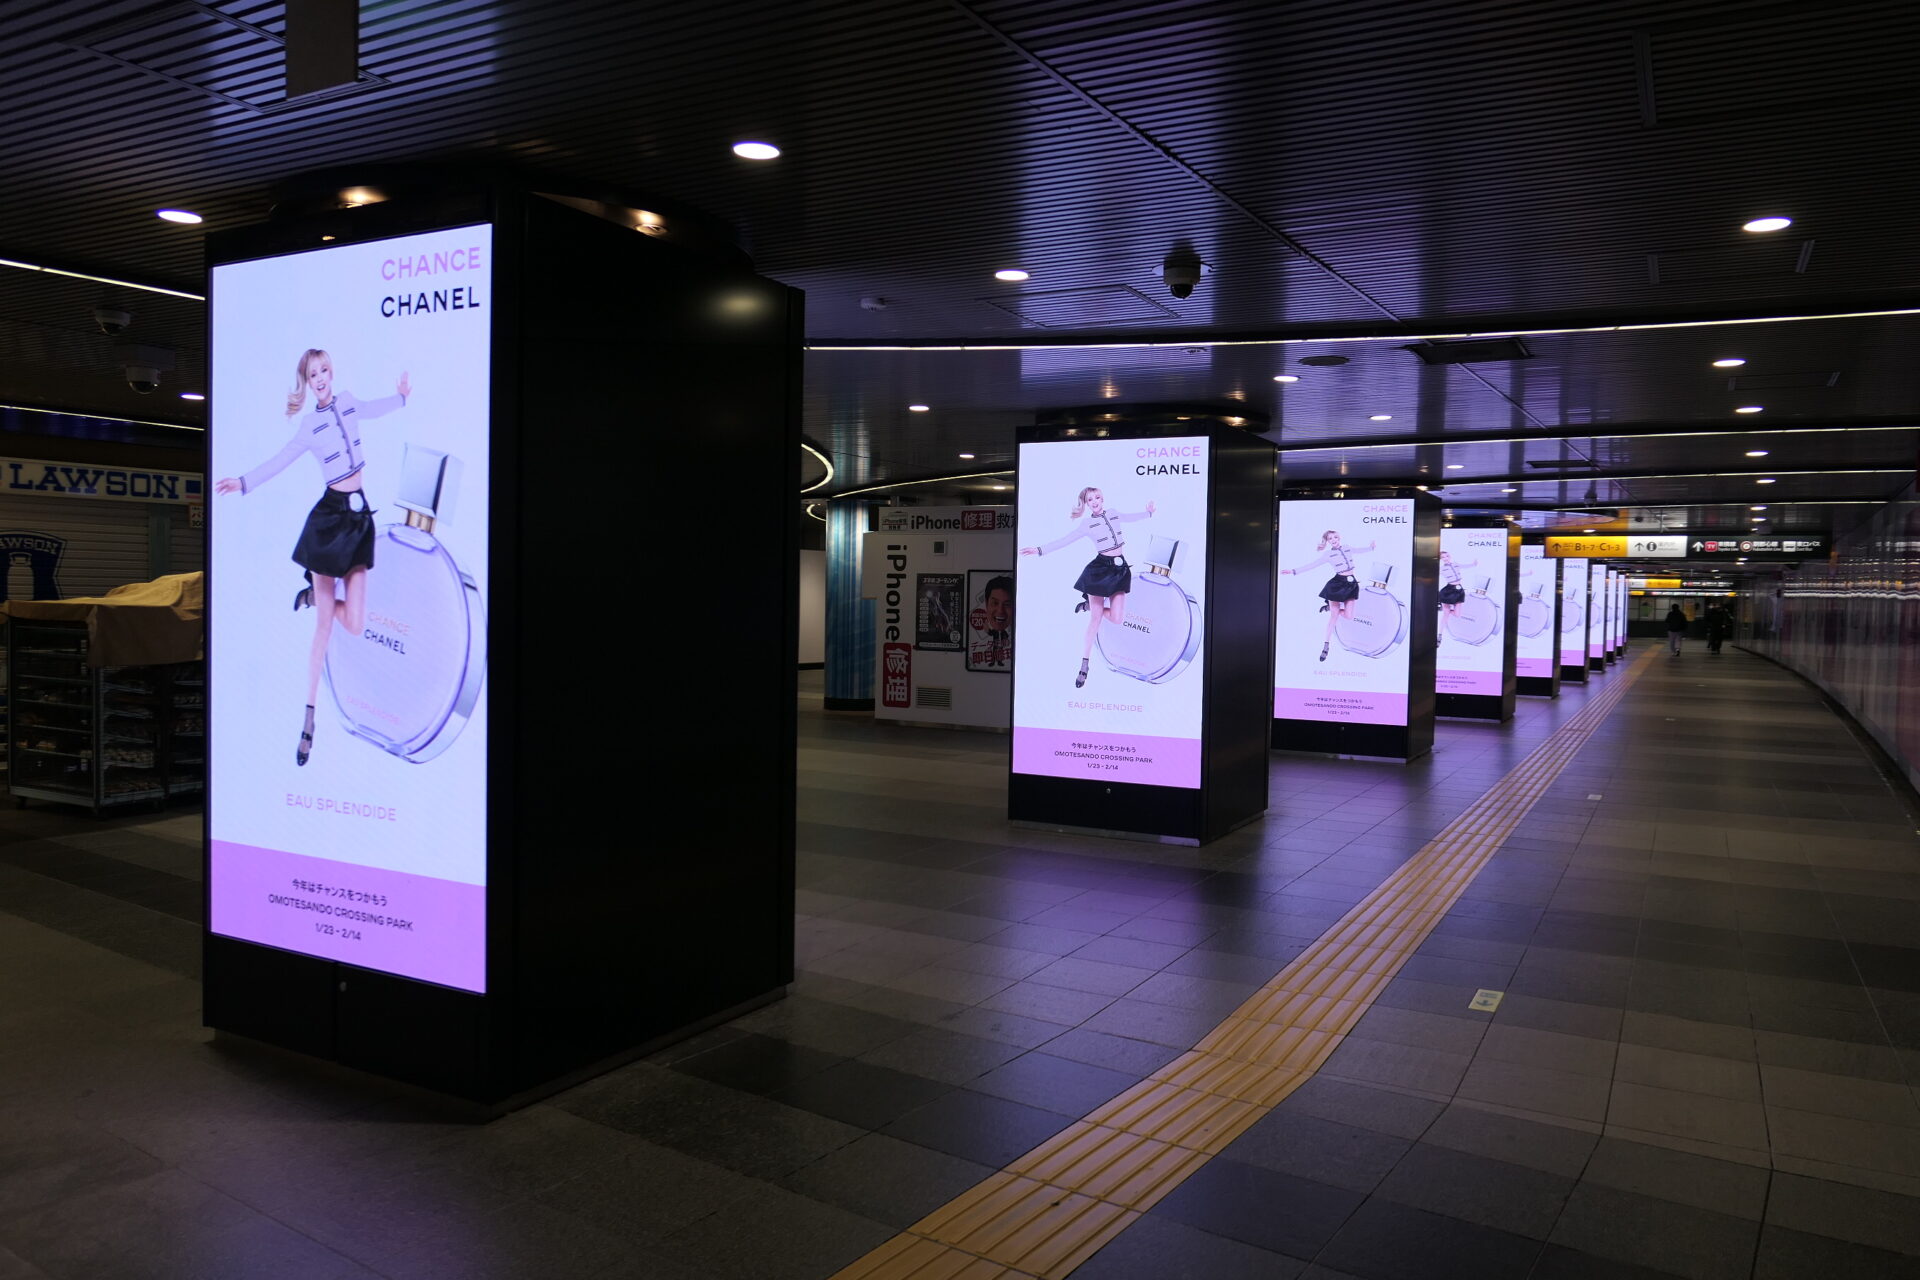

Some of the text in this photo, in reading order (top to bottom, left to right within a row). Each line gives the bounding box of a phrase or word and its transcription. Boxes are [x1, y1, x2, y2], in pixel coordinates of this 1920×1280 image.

[381, 246, 480, 281] CHANCE
[381, 286, 480, 318] CHANEL
[1136, 446, 1201, 458] CHANCE
[1135, 464, 1200, 476] CHANEL
[9, 463, 180, 499] LAWSON
[1362, 516, 1408, 524] CHANEL
[1123, 621, 1151, 634] CHANEL
[364, 629, 406, 655] CHANEL
[1067, 701, 1143, 713] EAU SPLENDIDE
[1054, 751, 1100, 760] OMOTESANDO
[1100, 754, 1134, 763] CROSSING
[1071, 742, 1137, 753] 今年はチャンスをつかもう
[286, 793, 397, 821] EAU SPLENDIDE
[292, 878, 388, 907] 今年はチャンスをつかもう
[268, 893, 414, 932] OMOTESANDO CROSSING PARK
[315, 922, 334, 936] 1/23
[341, 927, 362, 941] 2/14
